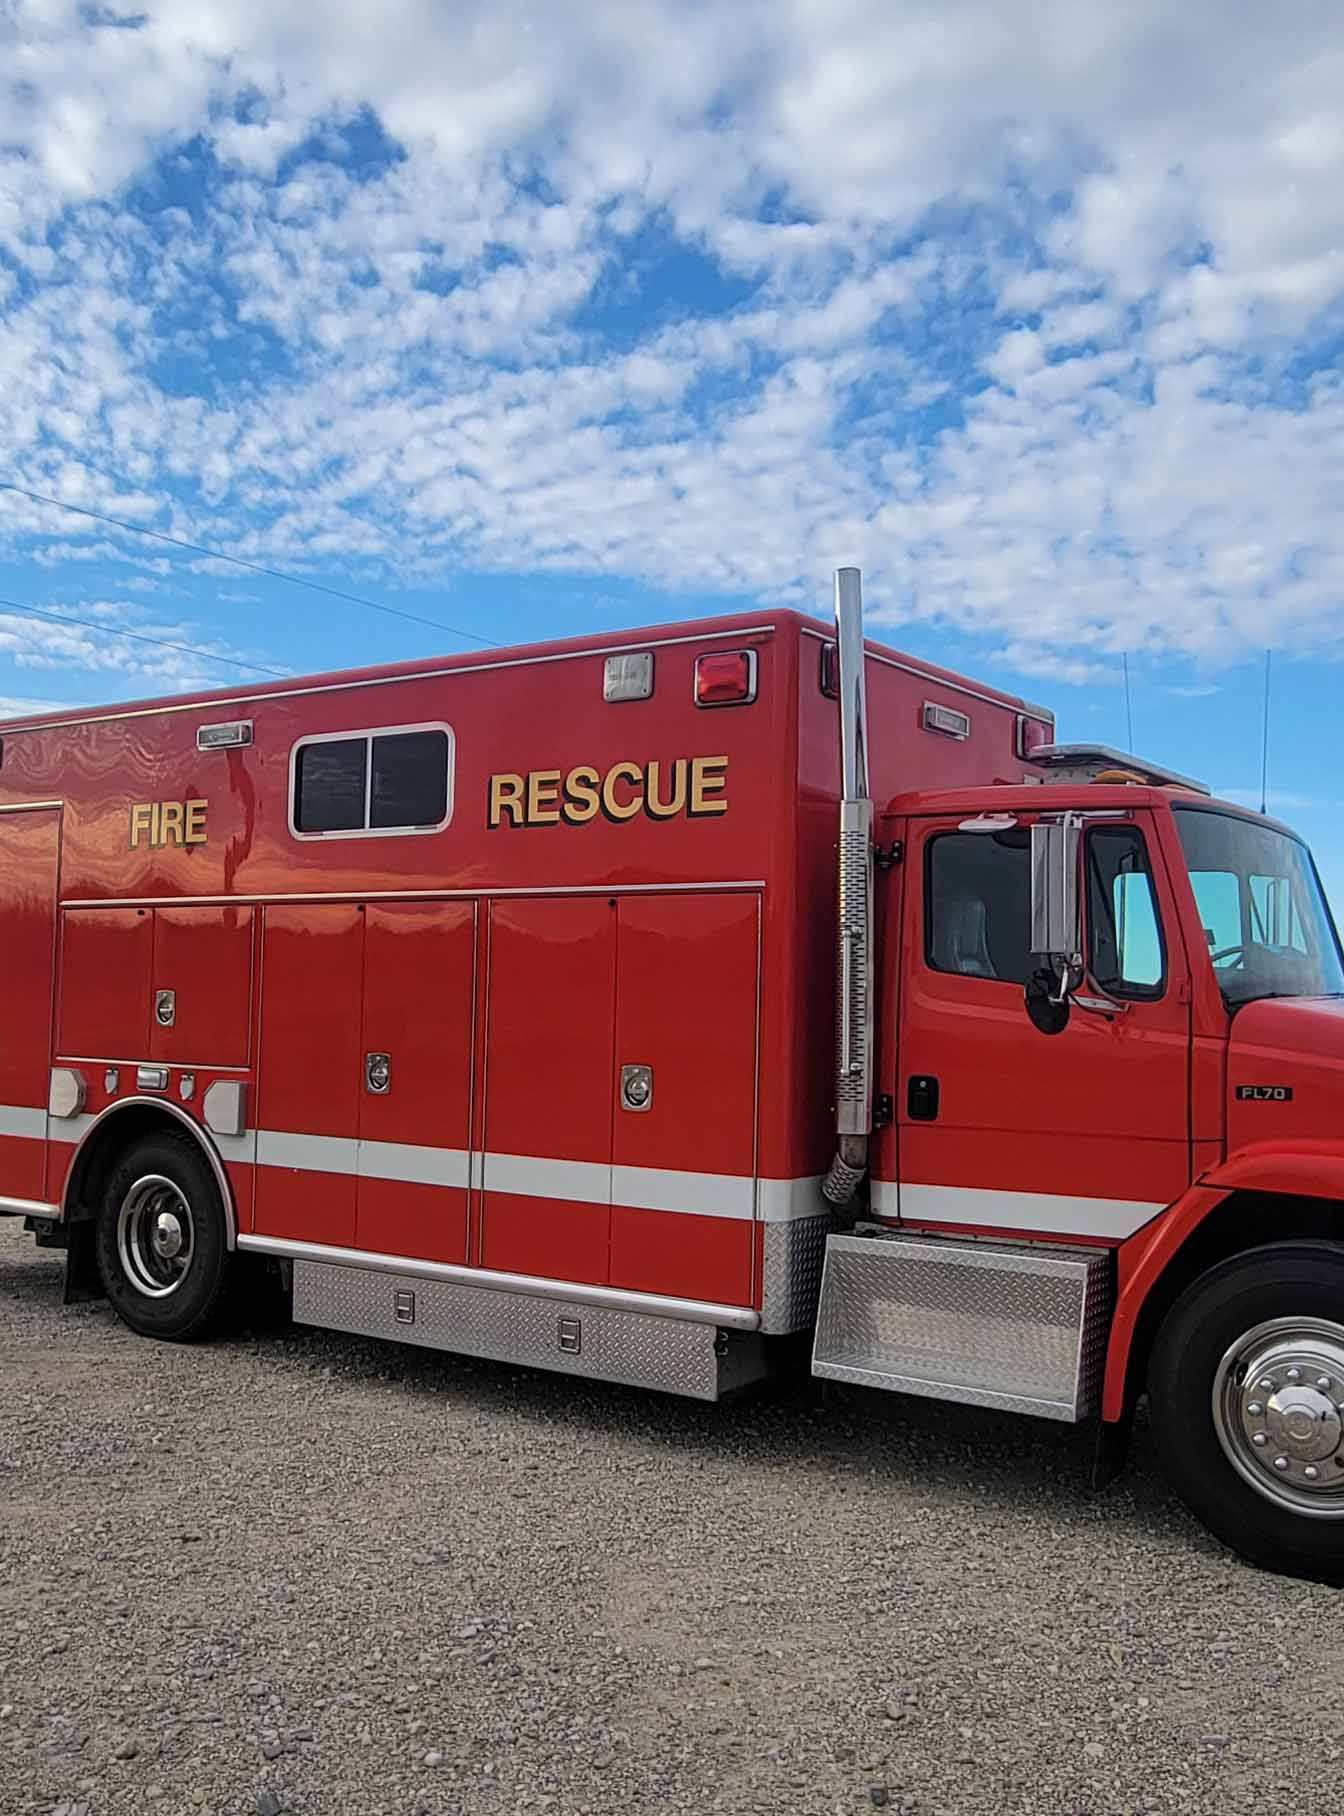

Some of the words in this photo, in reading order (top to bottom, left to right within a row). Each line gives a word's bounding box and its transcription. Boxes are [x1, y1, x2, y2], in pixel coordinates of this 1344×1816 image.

[129, 799, 209, 849] FIRE
[488, 755, 729, 828] RESCUE
[1241, 1087, 1286, 1100] FL70
